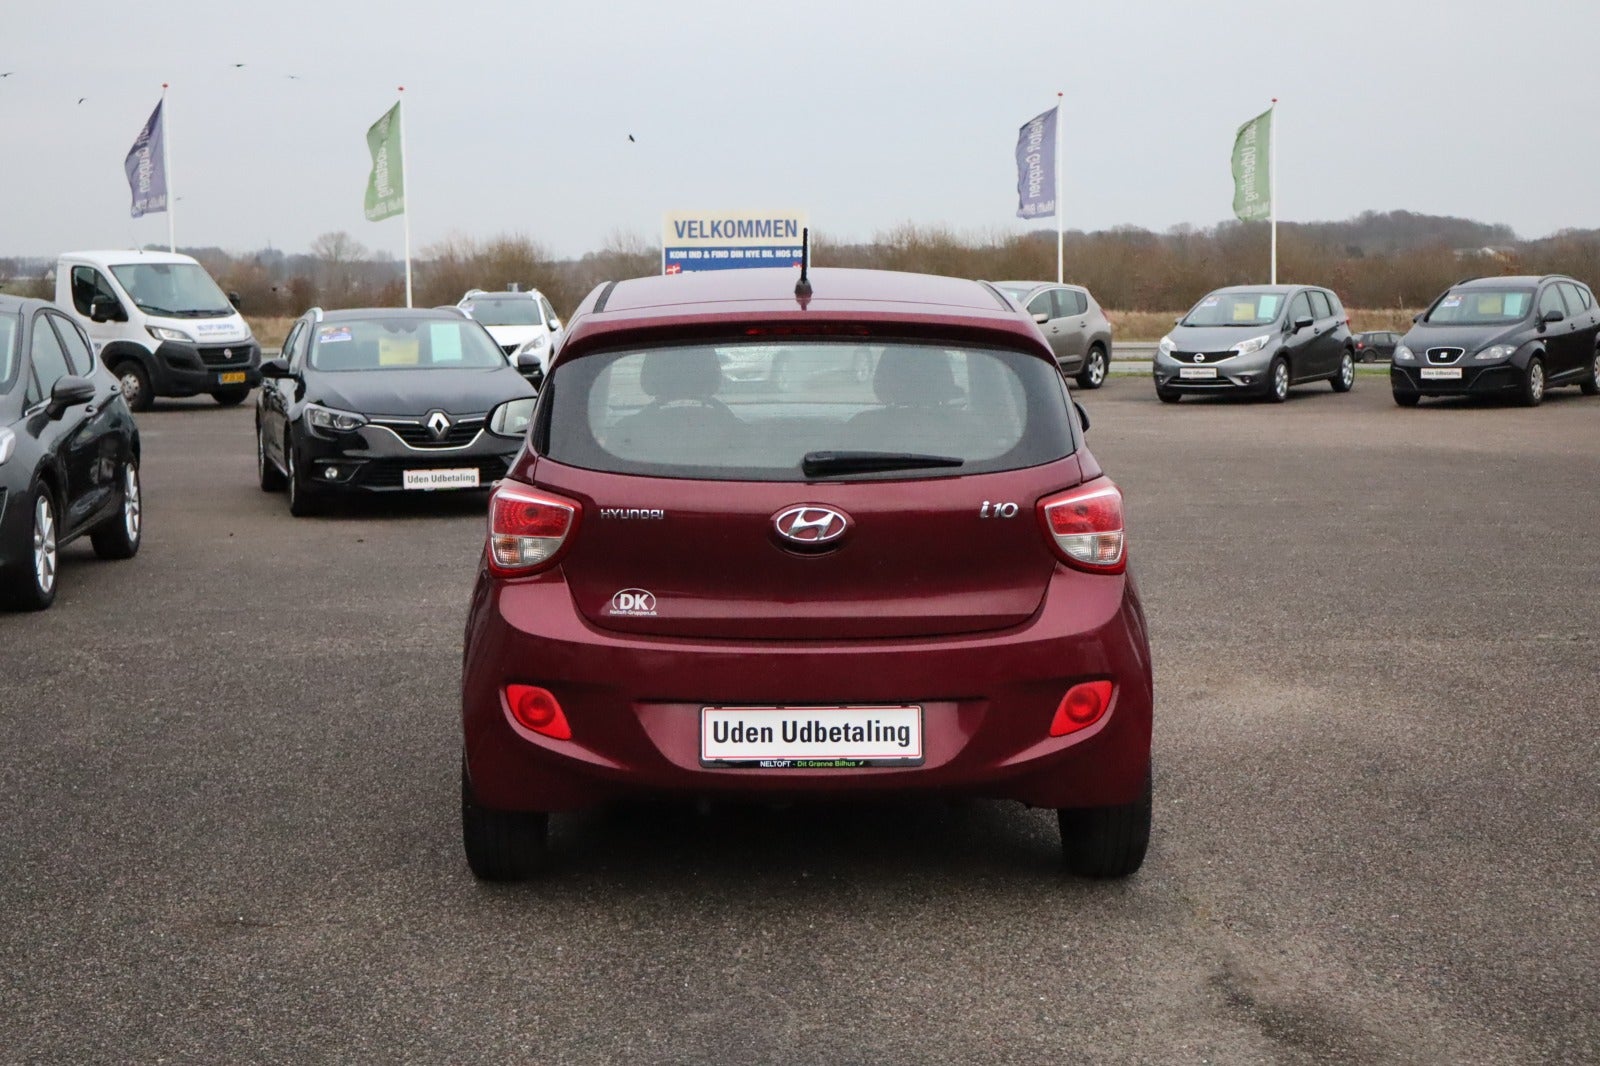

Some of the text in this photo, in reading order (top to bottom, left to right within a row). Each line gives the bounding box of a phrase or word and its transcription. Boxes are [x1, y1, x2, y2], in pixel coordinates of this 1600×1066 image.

[674, 219, 798, 239] VELKOMMEN
[669, 250, 687, 259] KOM
[688, 250, 702, 259] IND
[703, 250, 710, 259] &
[711, 250, 729, 259] FIND
[745, 249, 760, 258] NYE
[761, 249, 774, 258] BIL
[775, 249, 791, 258] HOS
[407, 473, 476, 484] Uden Udbetaling
[600, 508, 664, 520] HYUNDAI
[980, 500, 1019, 519] i10
[619, 593, 650, 611] DK
[713, 719, 911, 748] Uden Udbetaling
[760, 760, 791, 768] NELTOFT
